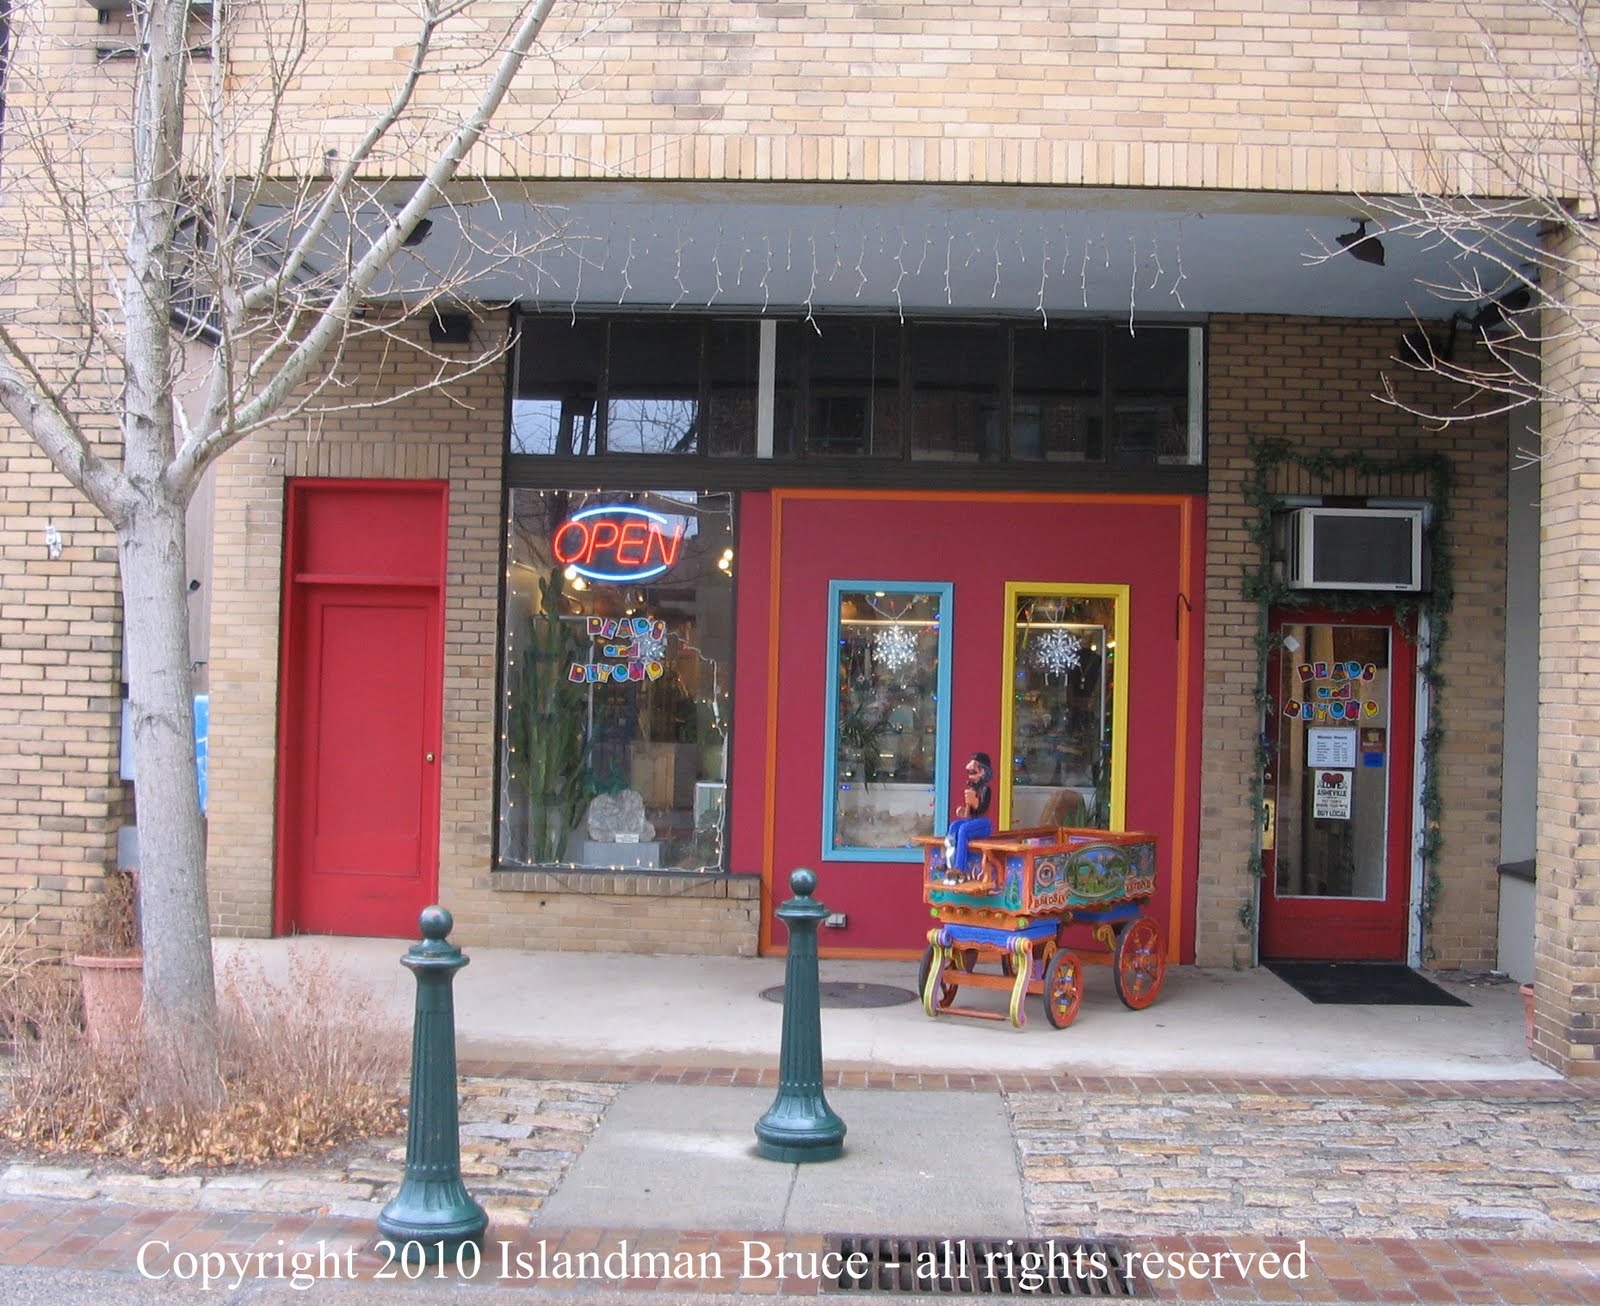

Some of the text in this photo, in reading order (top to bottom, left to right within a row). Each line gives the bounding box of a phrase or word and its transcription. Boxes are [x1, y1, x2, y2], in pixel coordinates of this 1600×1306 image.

[554, 521, 684, 566] OPEN
[587, 617, 666, 640] BEADS
[568, 662, 664, 684] BEYOND
[1297, 661, 1377, 683] BEADS
[1317, 684, 1351, 700] and
[1283, 699, 1379, 721] BEYOND
